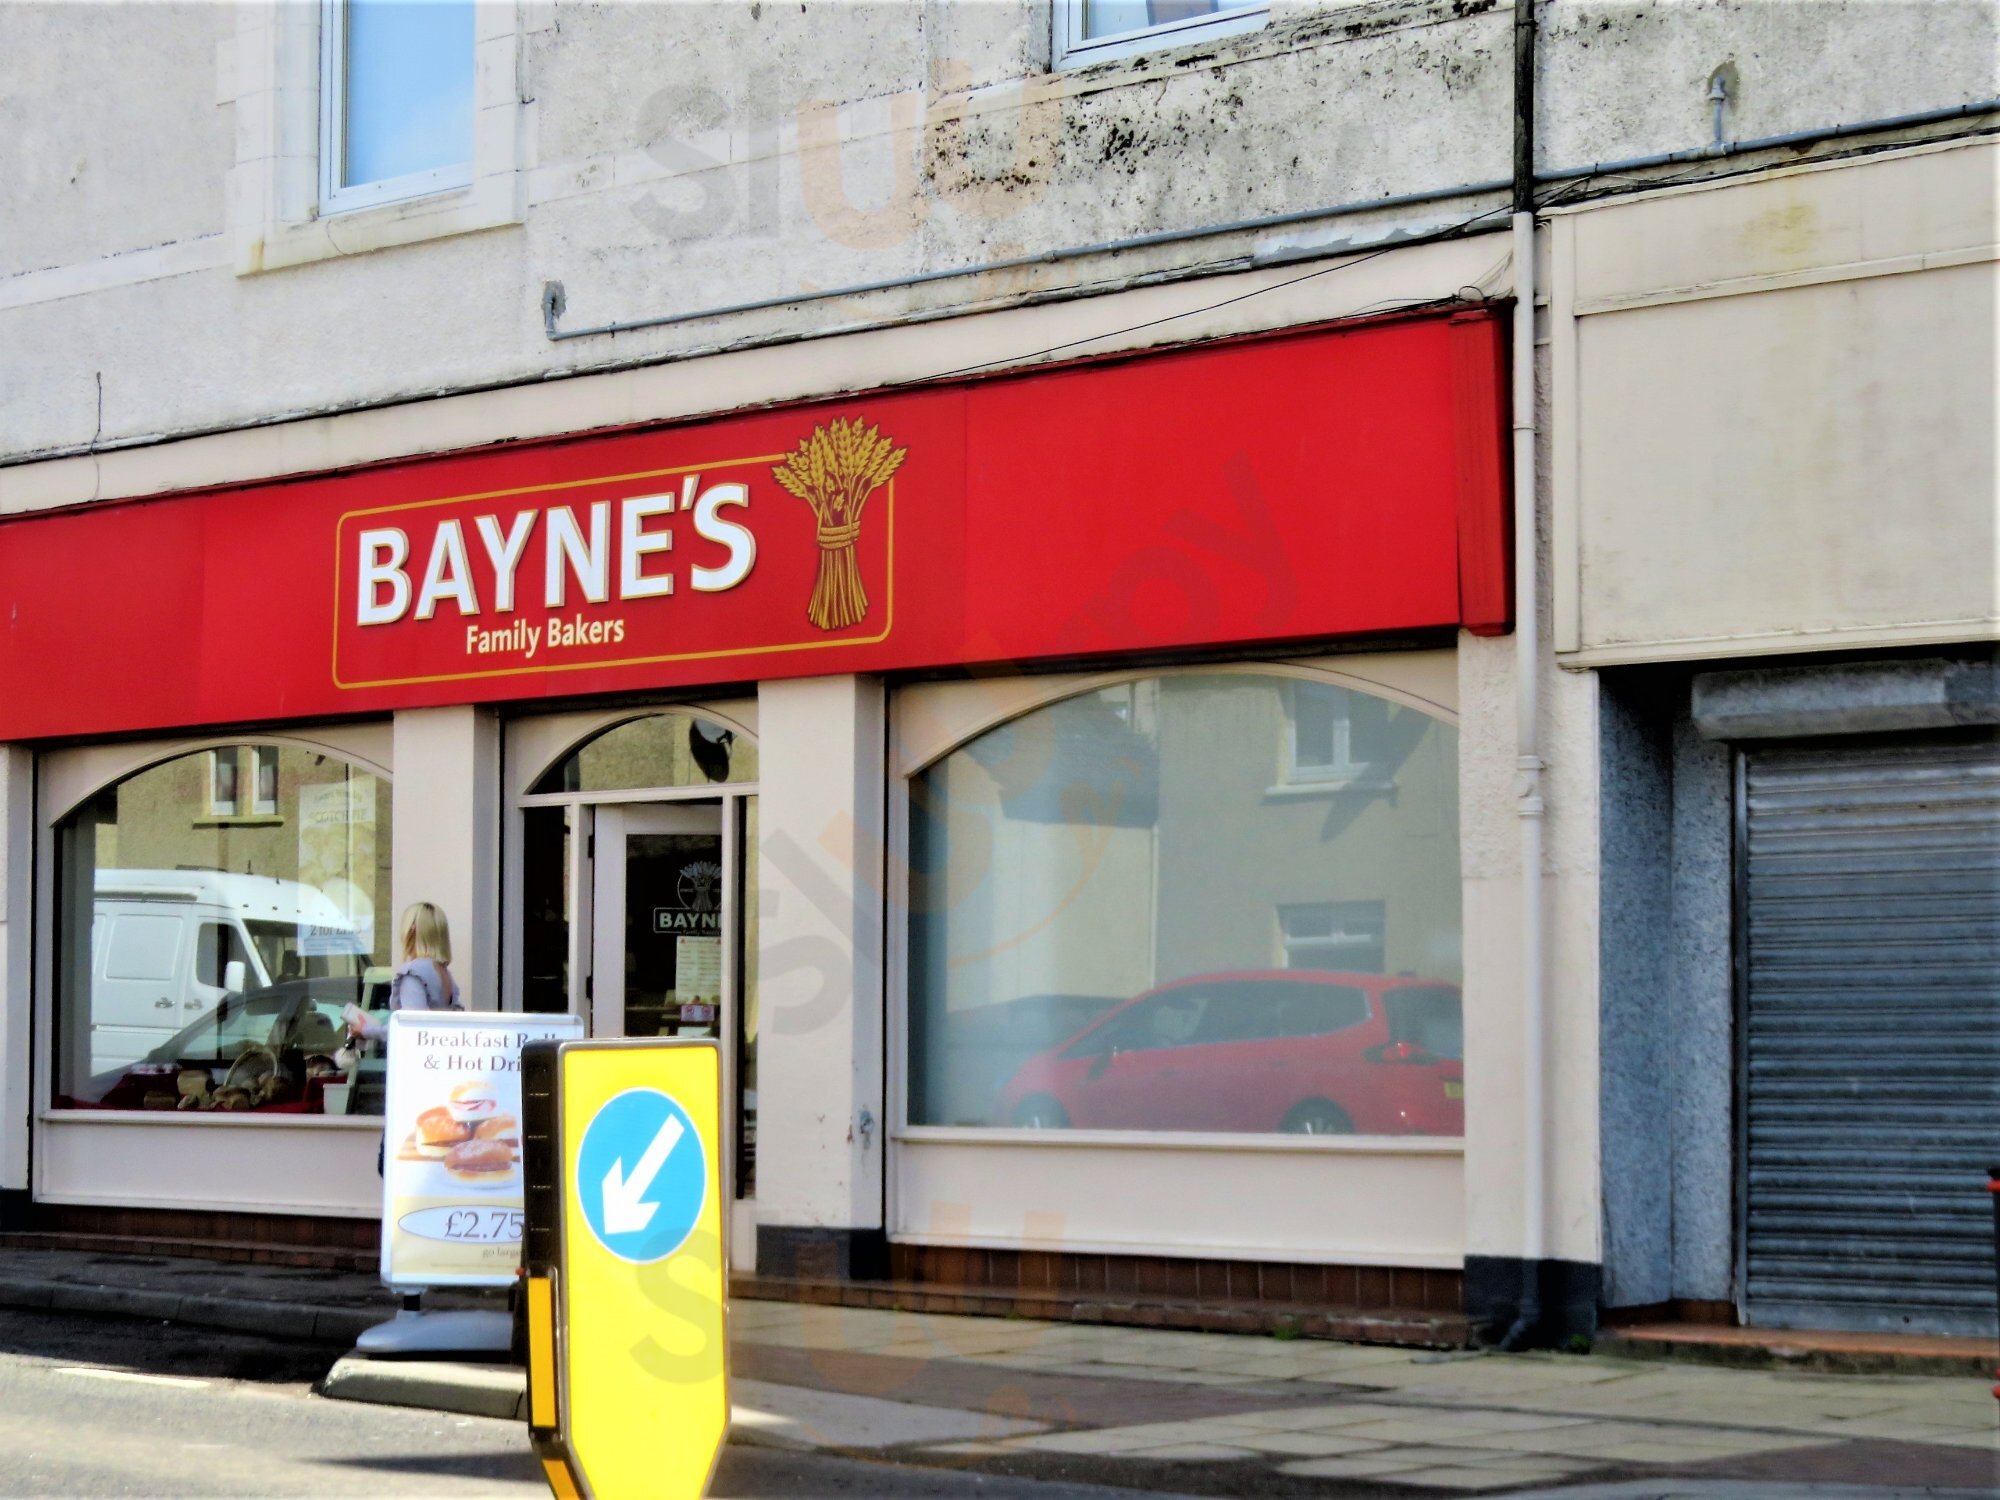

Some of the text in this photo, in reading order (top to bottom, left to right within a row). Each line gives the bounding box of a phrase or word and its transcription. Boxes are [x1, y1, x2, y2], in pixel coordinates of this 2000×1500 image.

[357, 475, 756, 627] BAYNE'S
[467, 613, 625, 658] Family Bakers
[417, 1030, 510, 1049] Breakfast
[424, 1053, 440, 1070] &
[447, 1054, 483, 1071] Hot
[444, 1210, 524, 1239] £2.75
